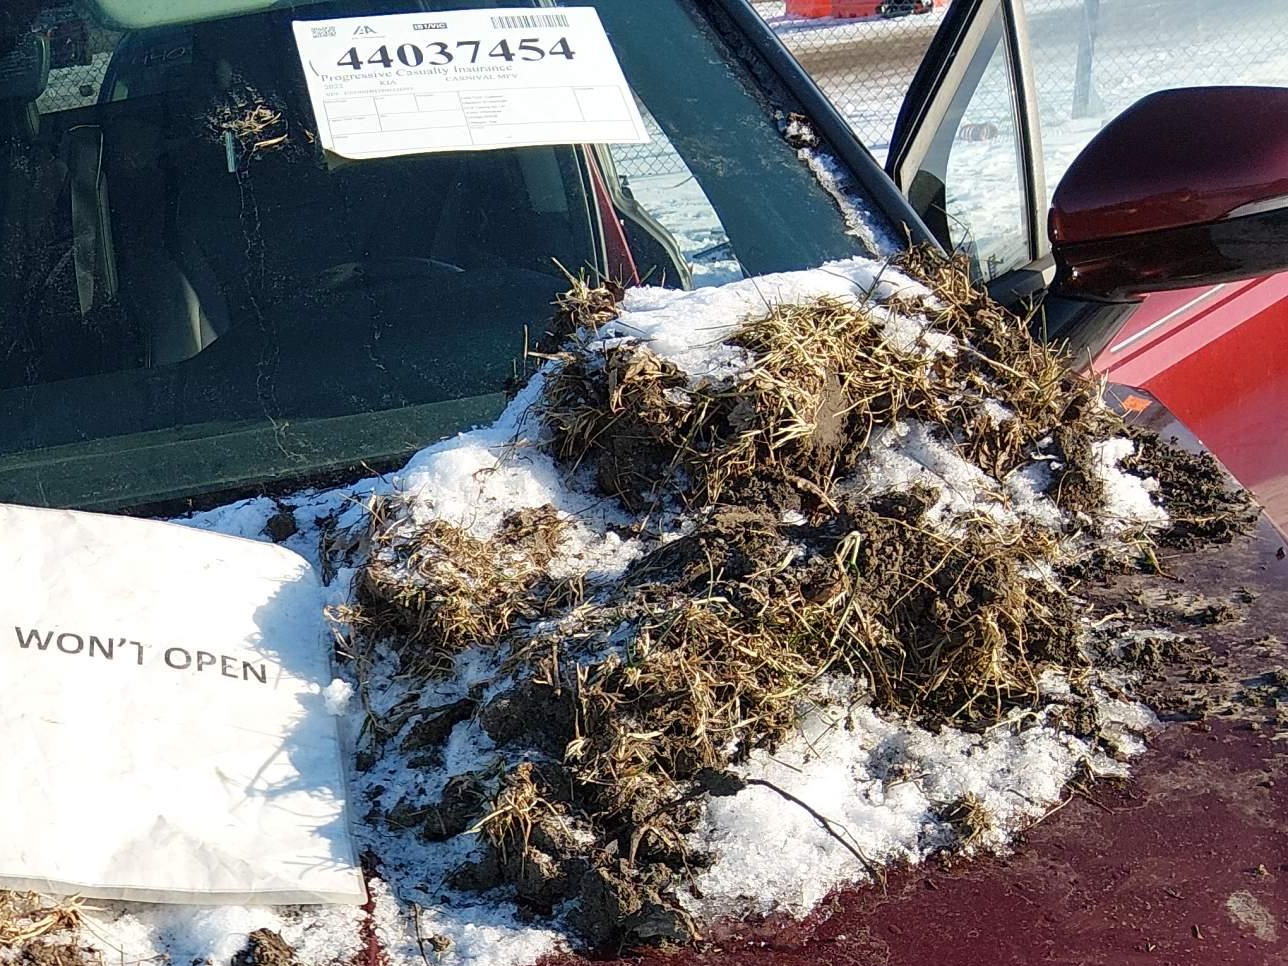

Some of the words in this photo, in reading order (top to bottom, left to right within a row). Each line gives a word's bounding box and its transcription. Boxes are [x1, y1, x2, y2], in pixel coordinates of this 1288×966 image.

[337, 37, 575, 70] 44037454
[321, 70, 392, 82] Progressive
[396, 66, 449, 77] Casualty
[454, 64, 513, 73] Insurance
[14, 626, 145, 666] WON'T
[164, 647, 267, 684] OPEN
